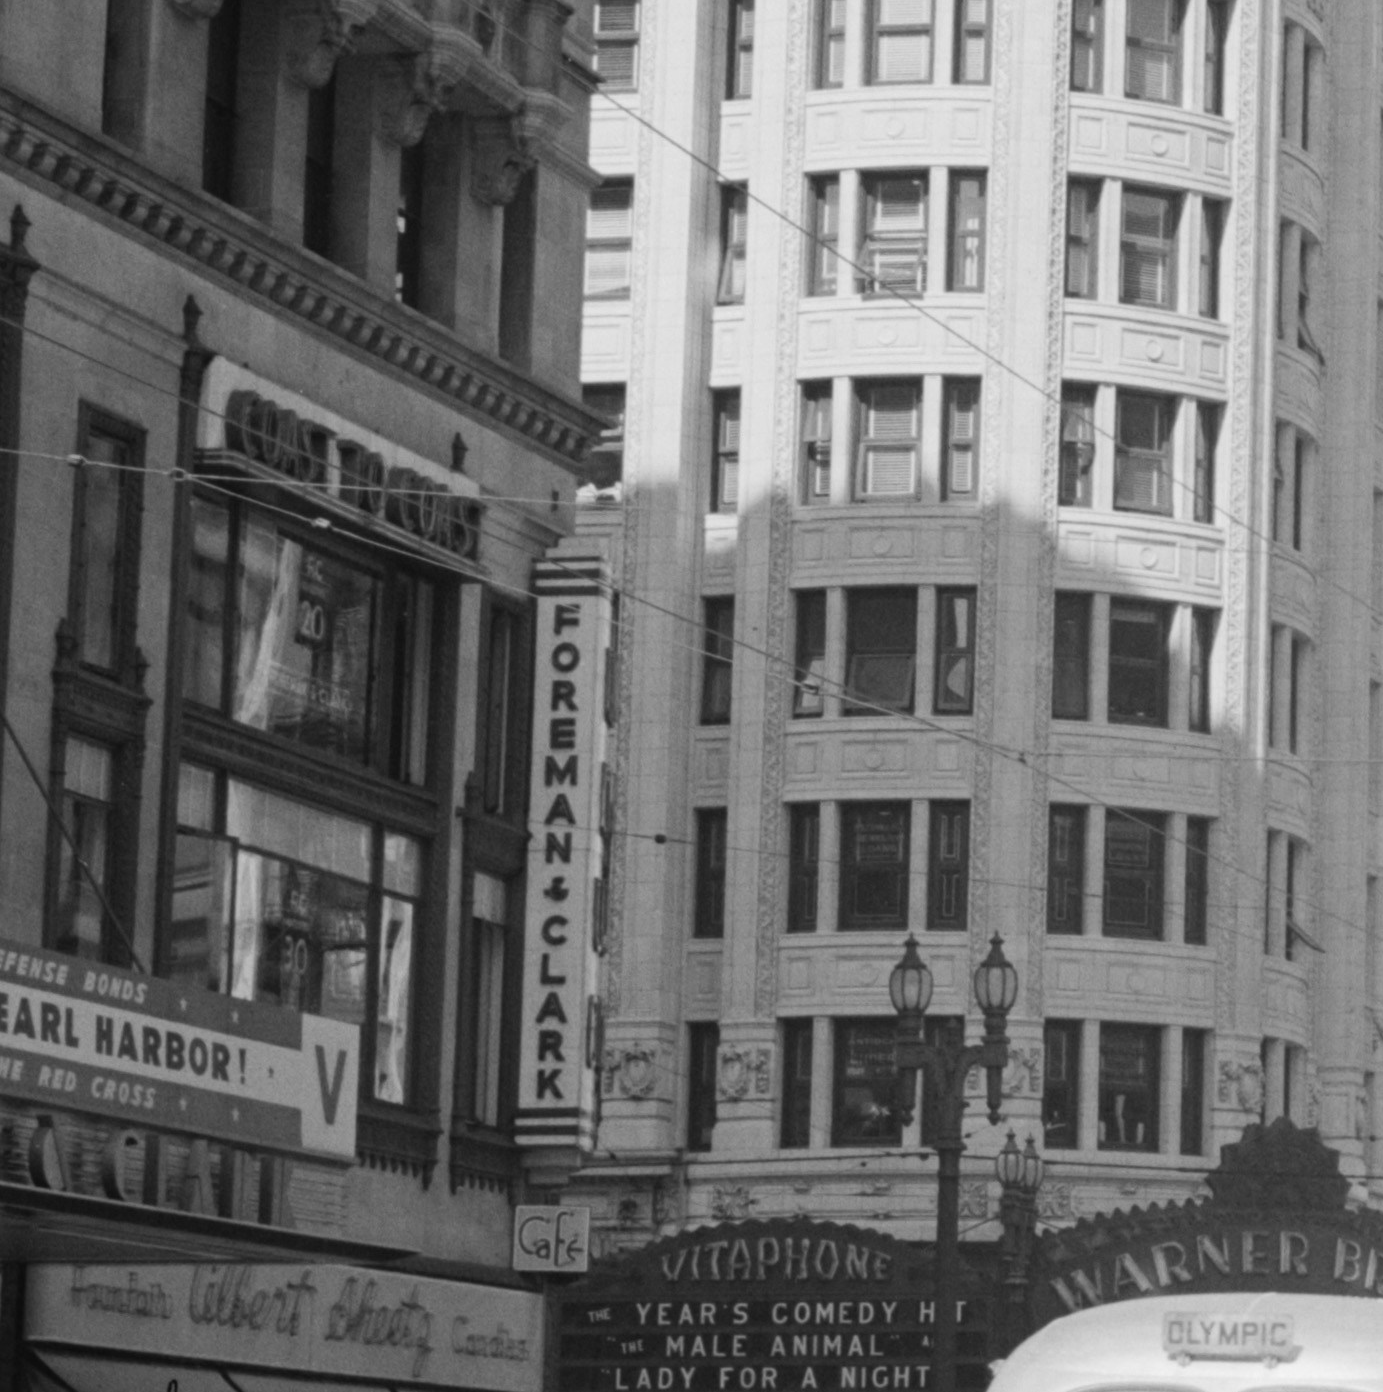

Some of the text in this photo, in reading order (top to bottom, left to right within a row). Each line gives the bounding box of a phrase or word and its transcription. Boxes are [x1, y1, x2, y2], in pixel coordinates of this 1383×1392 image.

[535, 605, 581, 1102] FOREMAN & CLARK
[84, 971, 149, 1004] BONDS
[95, 1015, 248, 1085] HARBOR!
[38, 1065, 78, 1093] RED
[91, 1076, 157, 1109] CROSS
[314, 1044, 348, 1127] V
[660, 1236, 894, 1284] VITAPHONE
[1051, 1230, 1310, 1313] WARNER
[588, 1299, 968, 1326] THE YEAR'S COMEDY HT
[1167, 1319, 1288, 1349] OLYMPIC
[665, 1334, 749, 1359] MALE
[718, 1366, 779, 1390] FOR
[800, 1366, 819, 1390] A
[840, 1365, 931, 1390] NIGHT
